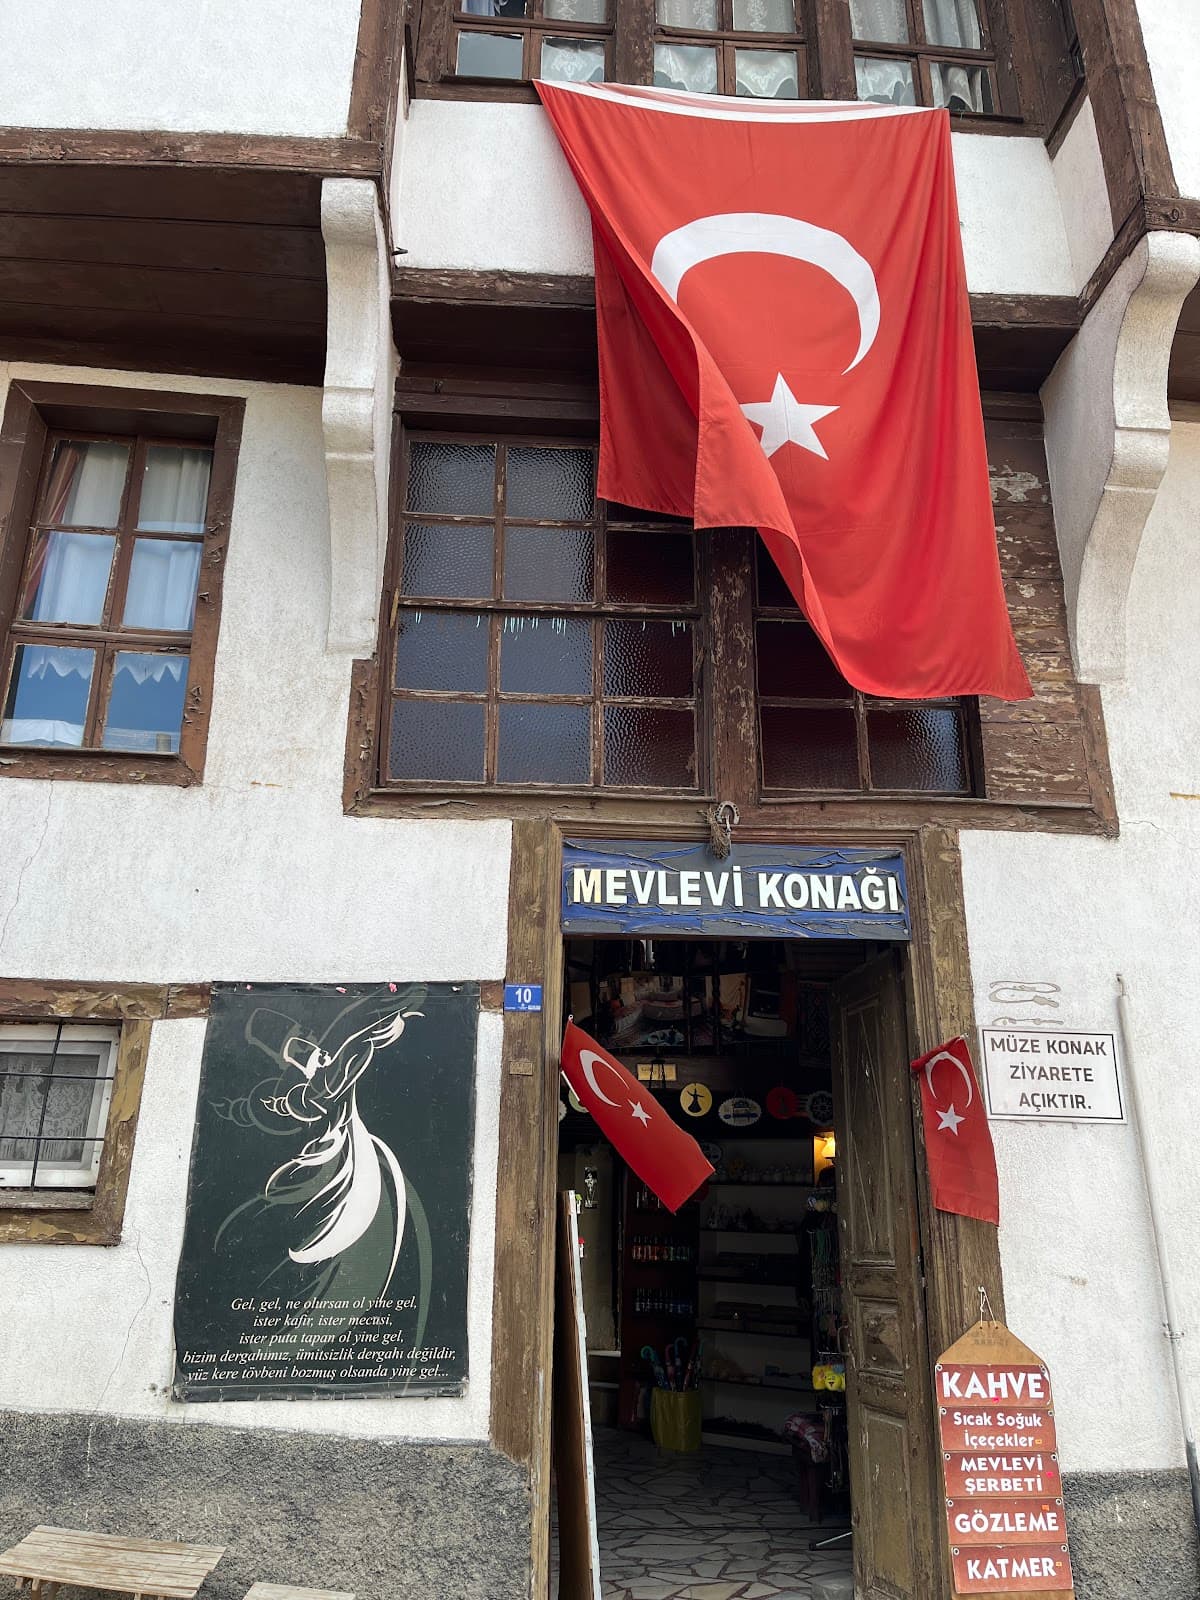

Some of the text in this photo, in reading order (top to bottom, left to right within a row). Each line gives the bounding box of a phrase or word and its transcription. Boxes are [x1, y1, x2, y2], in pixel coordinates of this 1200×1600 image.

[572, 866, 899, 911] MEVLEVİ KONAĞI
[515, 988, 532, 1003] 10
[990, 1034, 1107, 1056] MÜZE KONAK
[1010, 1062, 1094, 1082] ZİYARETE
[1019, 1092, 1092, 1112] AÇIKTIR.
[231, 1296, 417, 1313] Gel, gel, ne olursan ol yine gel,
[253, 1315, 281, 1327] ister
[283, 1314, 314, 1328] kafir,
[318, 1314, 346, 1326] ister
[239, 1330, 404, 1346] ister puta tapan ol yine gel,
[182, 1351, 216, 1364] bizim
[296, 1348, 355, 1361] ümitsizlik
[357, 1347, 403, 1362] dergahı
[406, 1346, 456, 1362] değildir,
[186, 1364, 449, 1383] yüz kere tövbeni bozmuş olsanda yine gel...
[942, 1371, 1044, 1399] KAHVE
[953, 1412, 1042, 1429] Sıcak Soğuk
[964, 1429, 1034, 1449] İçeçekler
[961, 1454, 1043, 1472] MEVLEVİ
[965, 1475, 1042, 1495] ŞERBETİ
[954, 1509, 1059, 1533] GÖZLEME
[966, 1557, 1057, 1580] KATMER
